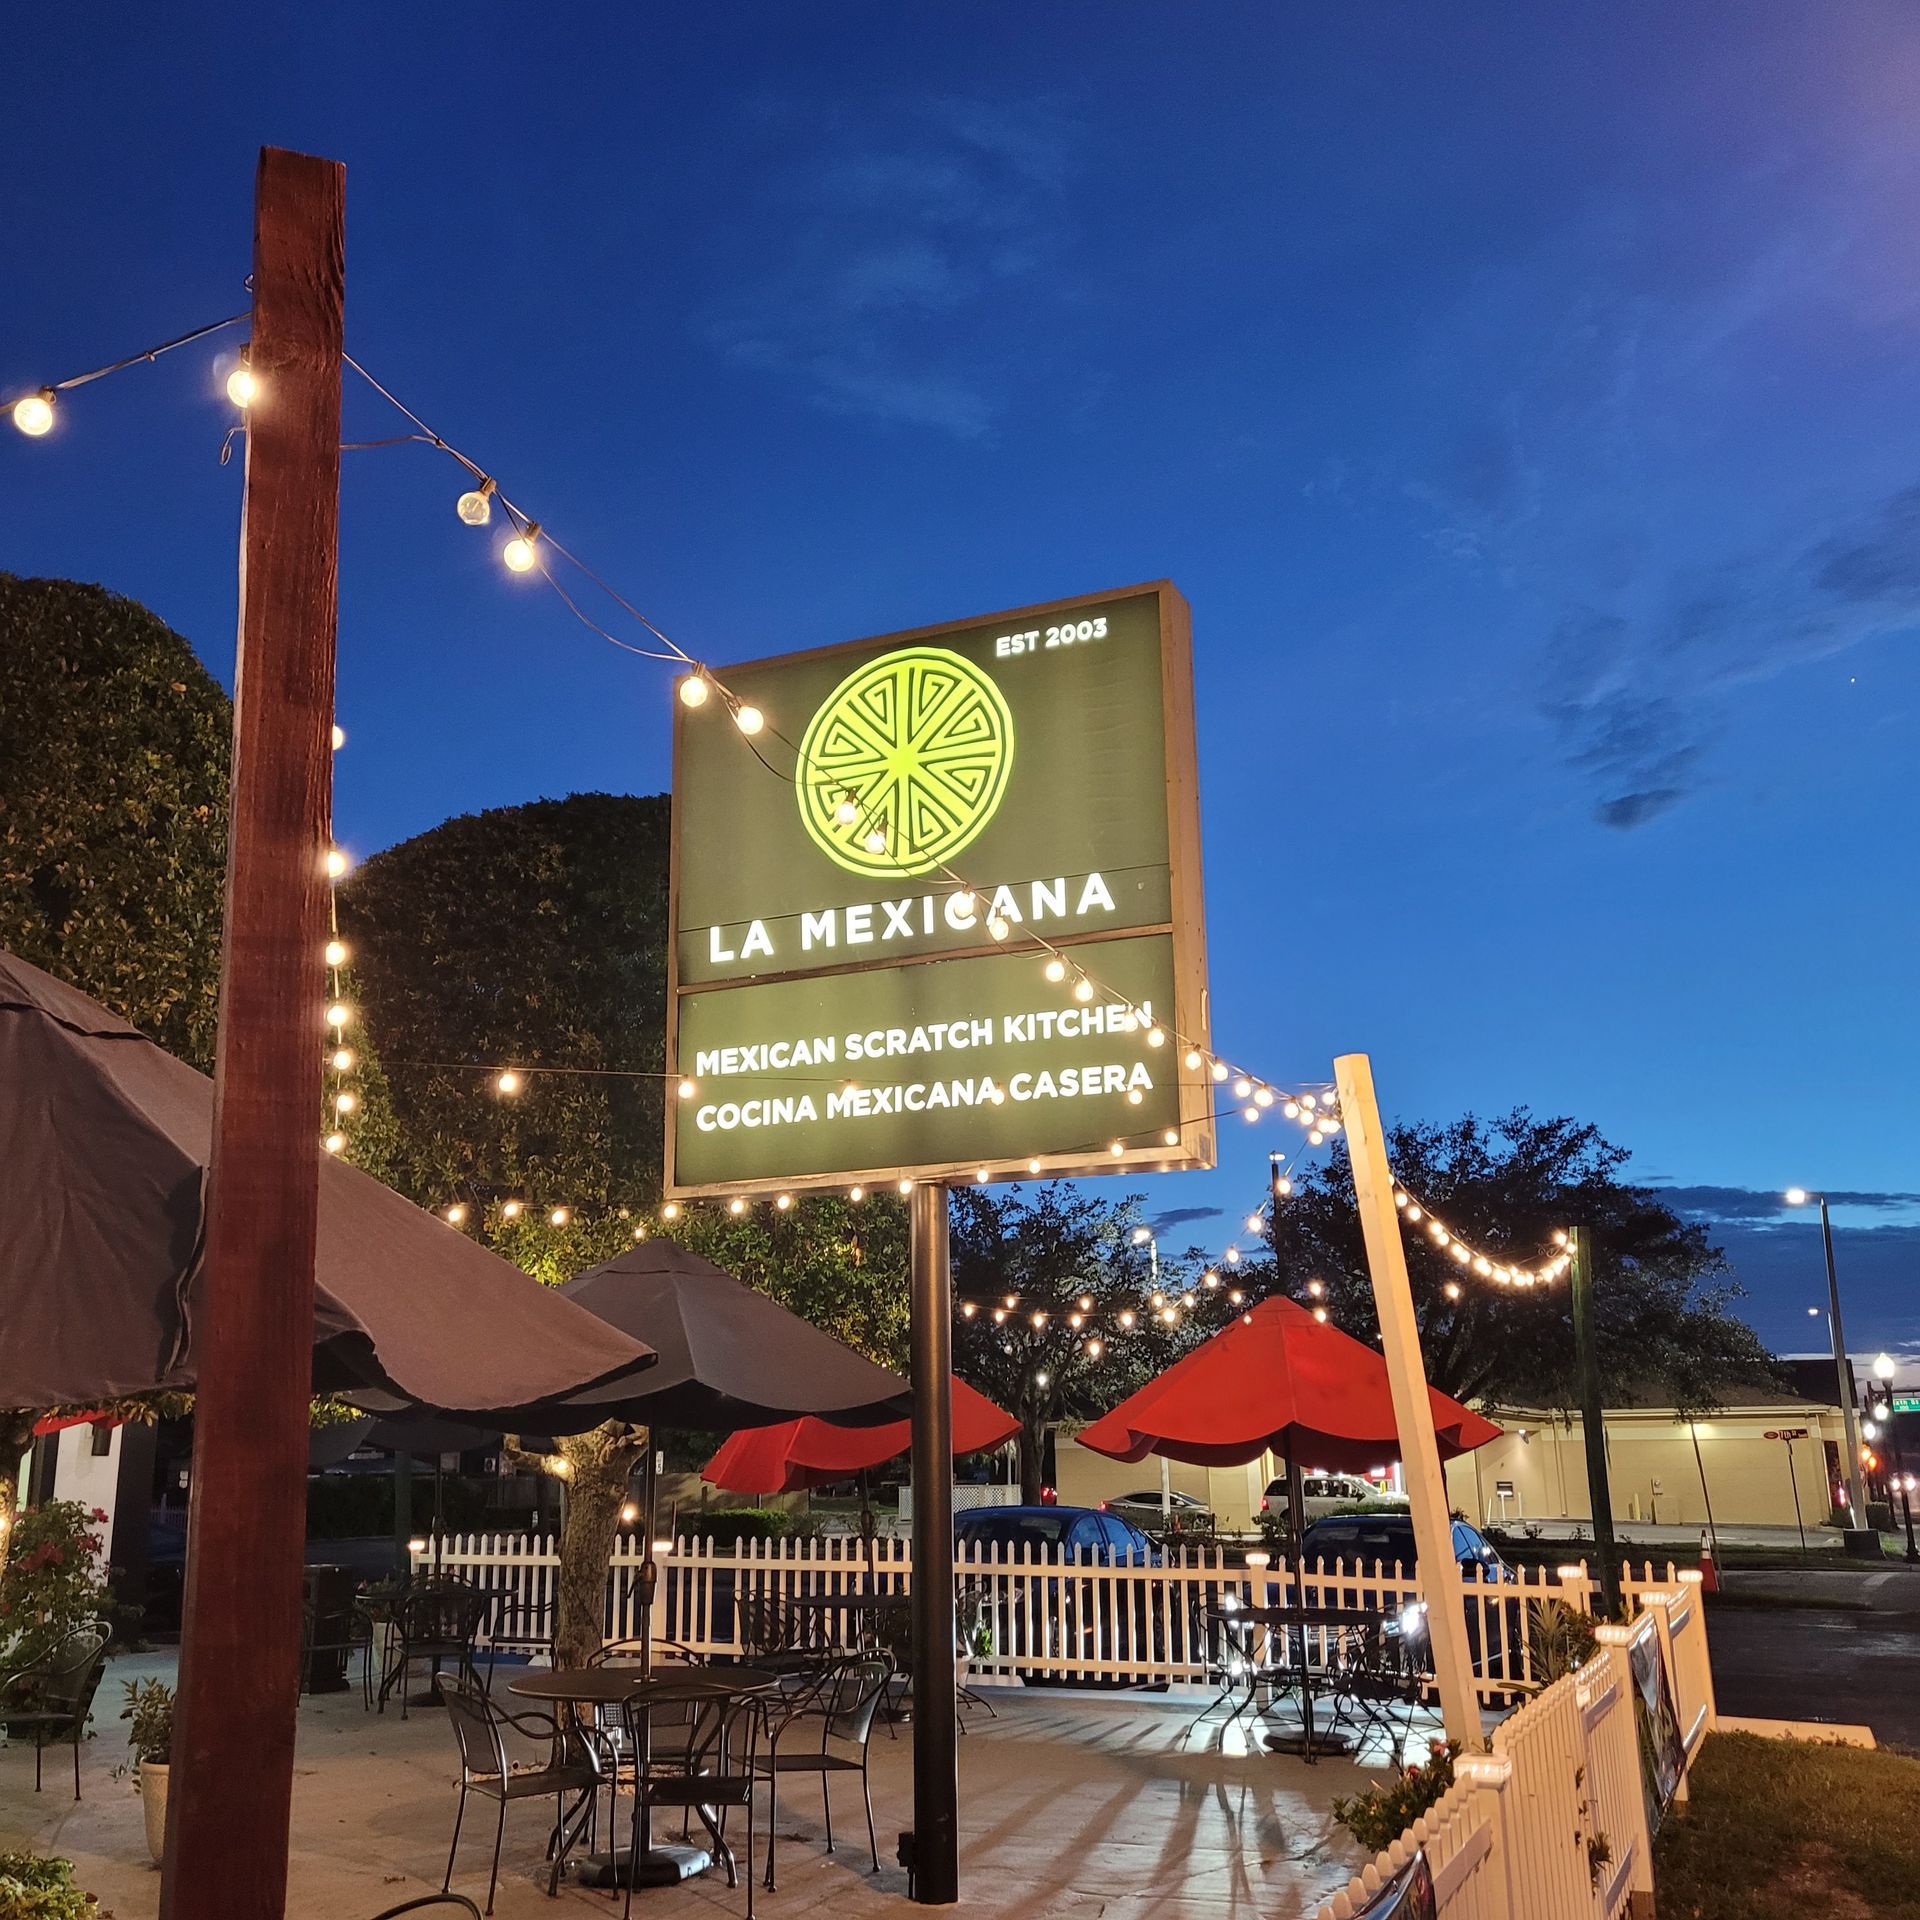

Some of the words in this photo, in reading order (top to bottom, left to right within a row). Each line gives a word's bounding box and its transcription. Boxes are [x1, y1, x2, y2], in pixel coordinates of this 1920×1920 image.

[996, 630, 1040, 658] EST
[1045, 616, 1108, 649] 2003
[709, 919, 775, 964] LA
[801, 872, 1117, 952] MEXICANA
[695, 1035, 836, 1078] MEXICAN
[843, 1017, 994, 1062] SCRATCH
[1003, 1000, 1153, 1044] KITCHEN
[695, 1094, 818, 1133] COCINA
[826, 1076, 1002, 1121] MEXICANA
[1009, 1061, 1154, 1102] CASERA
